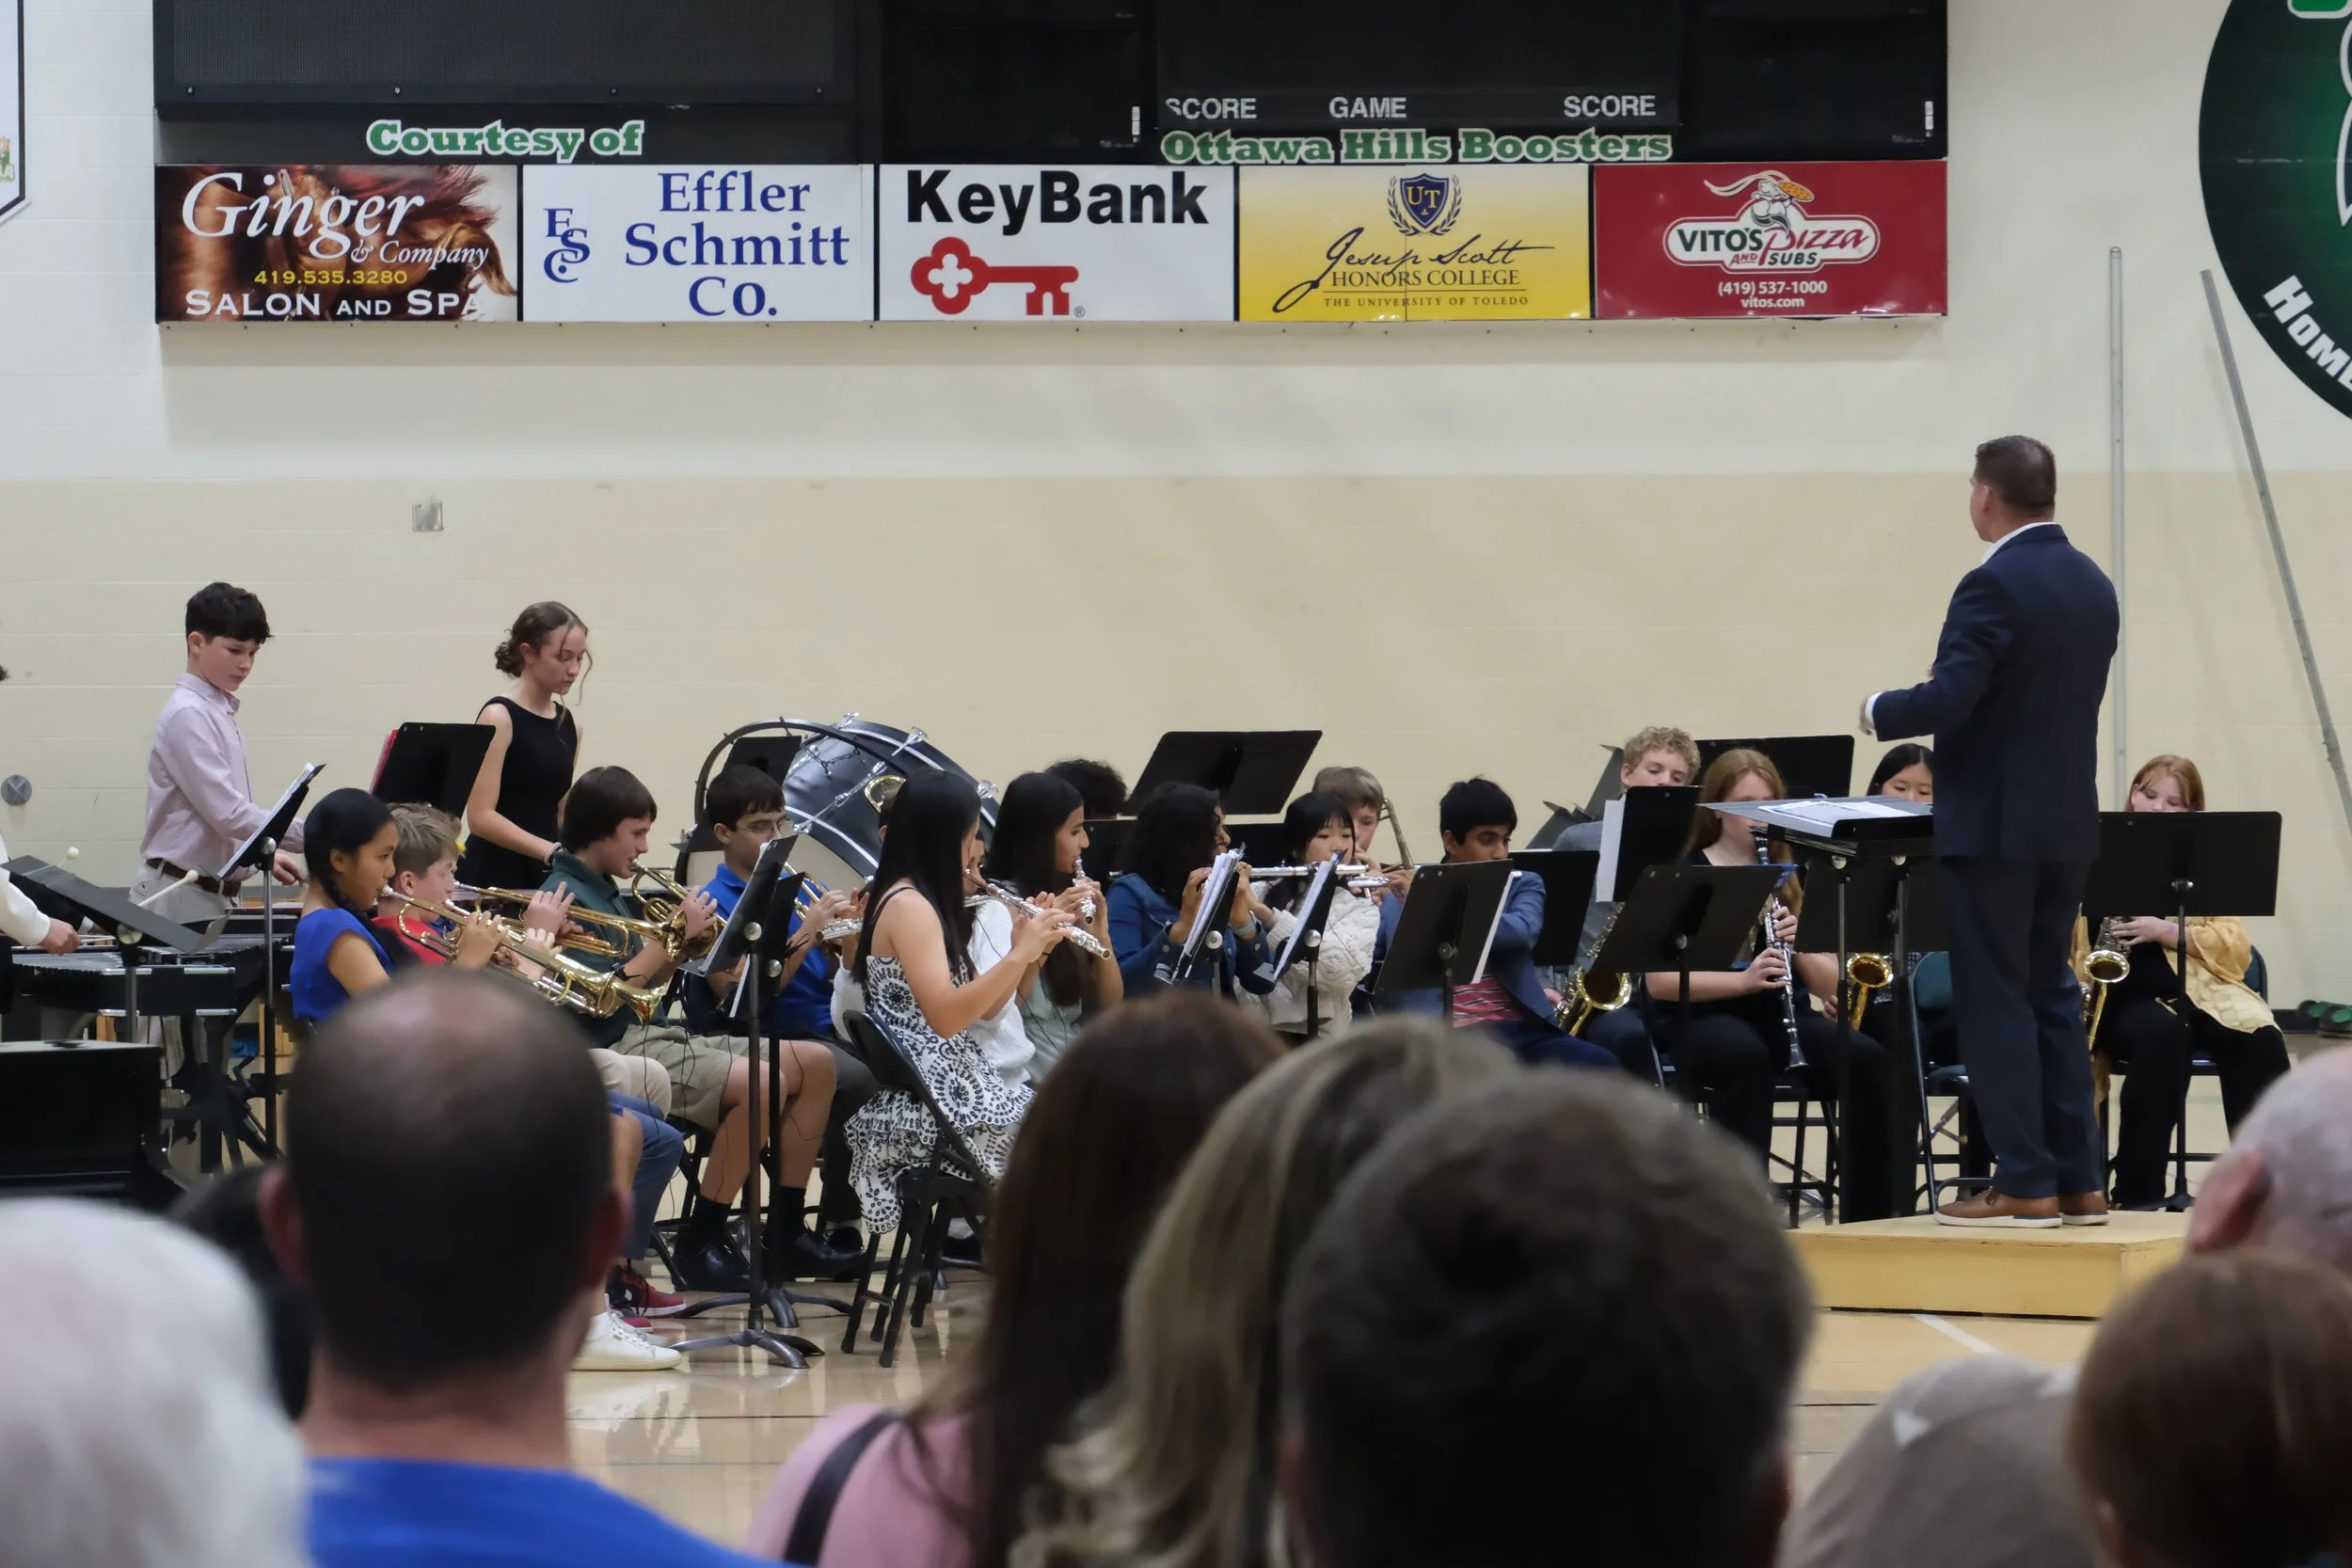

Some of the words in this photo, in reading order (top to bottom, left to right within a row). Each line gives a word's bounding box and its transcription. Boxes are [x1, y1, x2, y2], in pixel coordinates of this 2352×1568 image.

[1328, 97, 1407, 119] GAME
[1563, 95, 1657, 118] SCORE
[366, 119, 585, 164] Courtesy
[589, 119, 644, 156] of
[1160, 129, 1332, 165] Ottawa
[1340, 128, 1453, 163] Hills
[1458, 127, 1673, 163] Boosters
[659, 171, 811, 213] Effler
[907, 169, 1210, 236] KeyBank
[1406, 185, 1440, 209] UT
[181, 173, 425, 261] Ginger
[625, 222, 850, 266] Schmitt
[1677, 228, 1763, 252] VITO'S
[350, 238, 374, 263] &
[379, 240, 489, 272] Company
[1729, 252, 1757, 266] AND
[1768, 251, 1818, 265] SUBS
[254, 269, 408, 285] 419.535.3280
[1272, 227, 1422, 312] Jesup
[1429, 234, 1555, 265] Scott
[1332, 270, 1422, 287] HONORS
[1427, 269, 1520, 286] COLLEGE
[689, 276, 777, 317] Co.
[1718, 281, 1756, 296] (419)
[1759, 280, 1827, 294] 537-1000
[186, 289, 321, 316] SALON
[336, 299, 391, 315] AND
[1325, 298, 1351, 308] THE
[1358, 297, 1442, 307] UNIVERSITY
[1449, 297, 1466, 306] OF
[1473, 296, 1529, 306] TOLEDO
[1741, 295, 1804, 309] vitos.com
